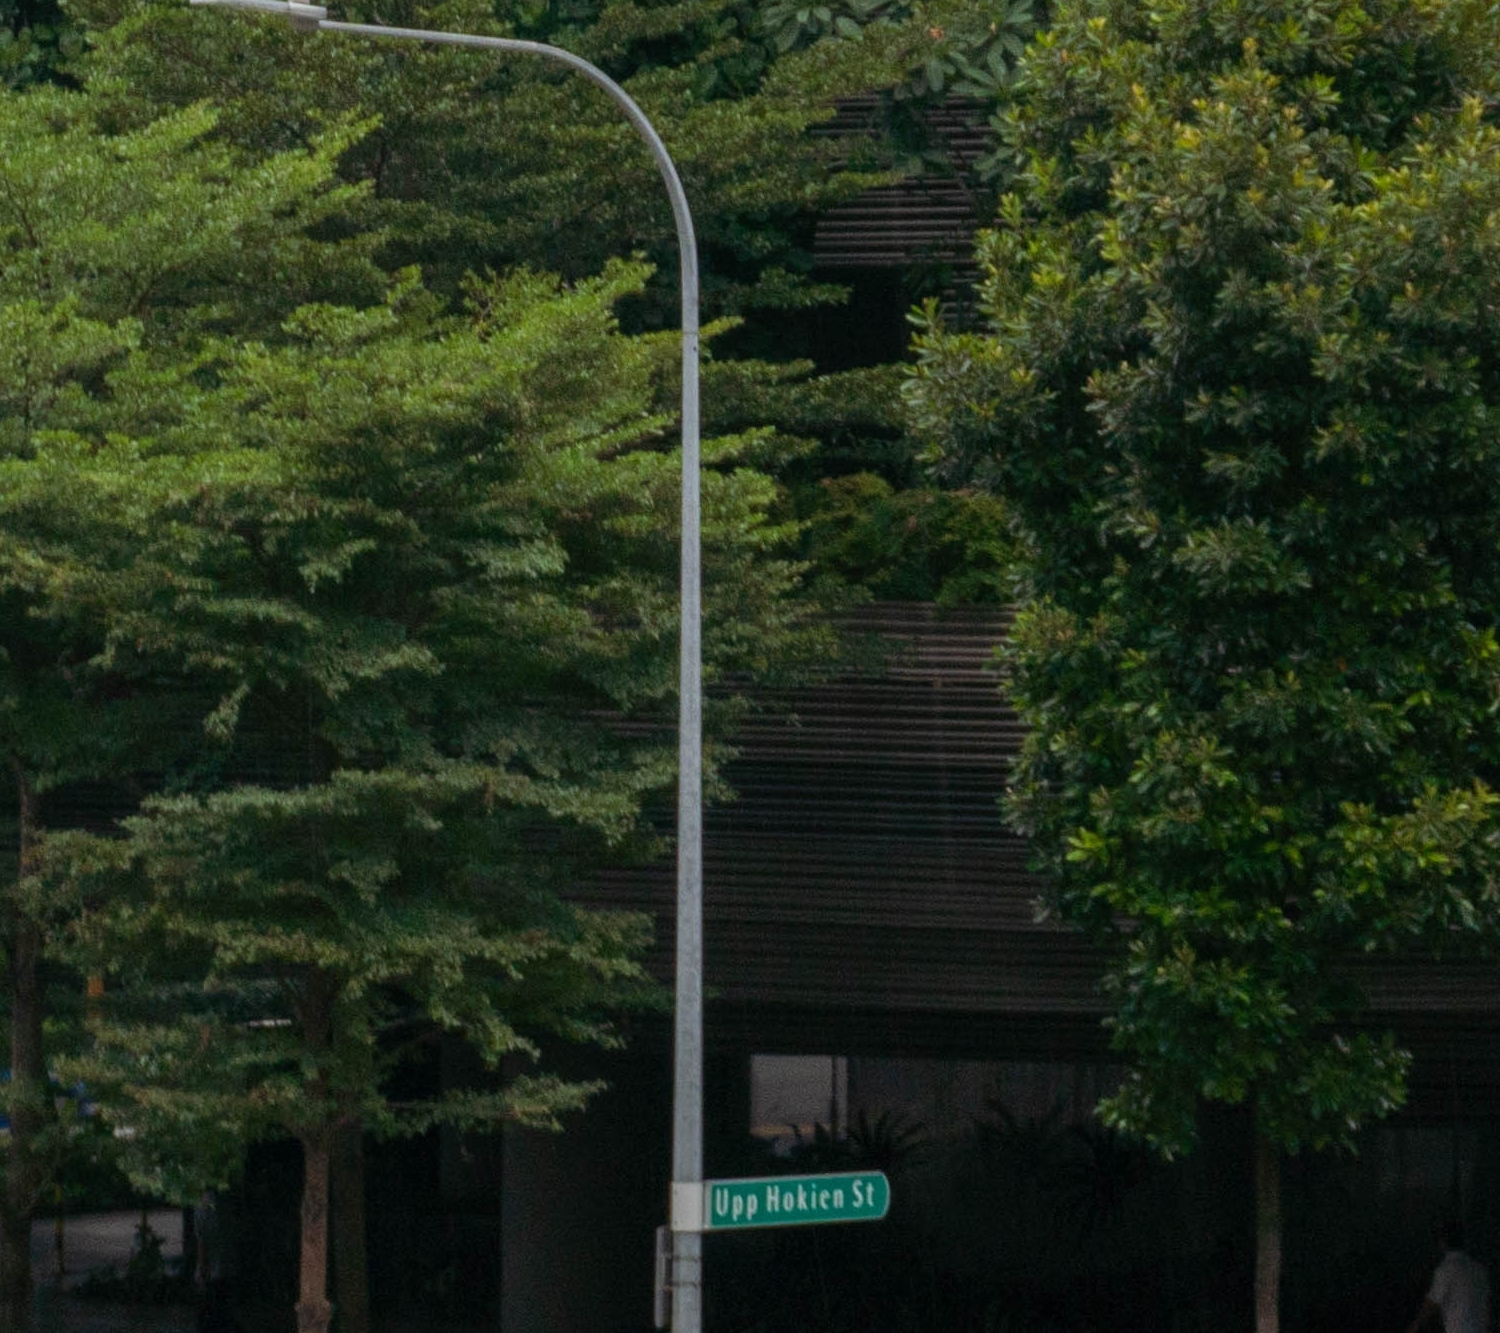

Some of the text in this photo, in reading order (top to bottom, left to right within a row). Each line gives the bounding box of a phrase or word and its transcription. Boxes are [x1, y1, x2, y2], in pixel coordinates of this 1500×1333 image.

[715, 1179, 875, 1221] Upp Hokien St
